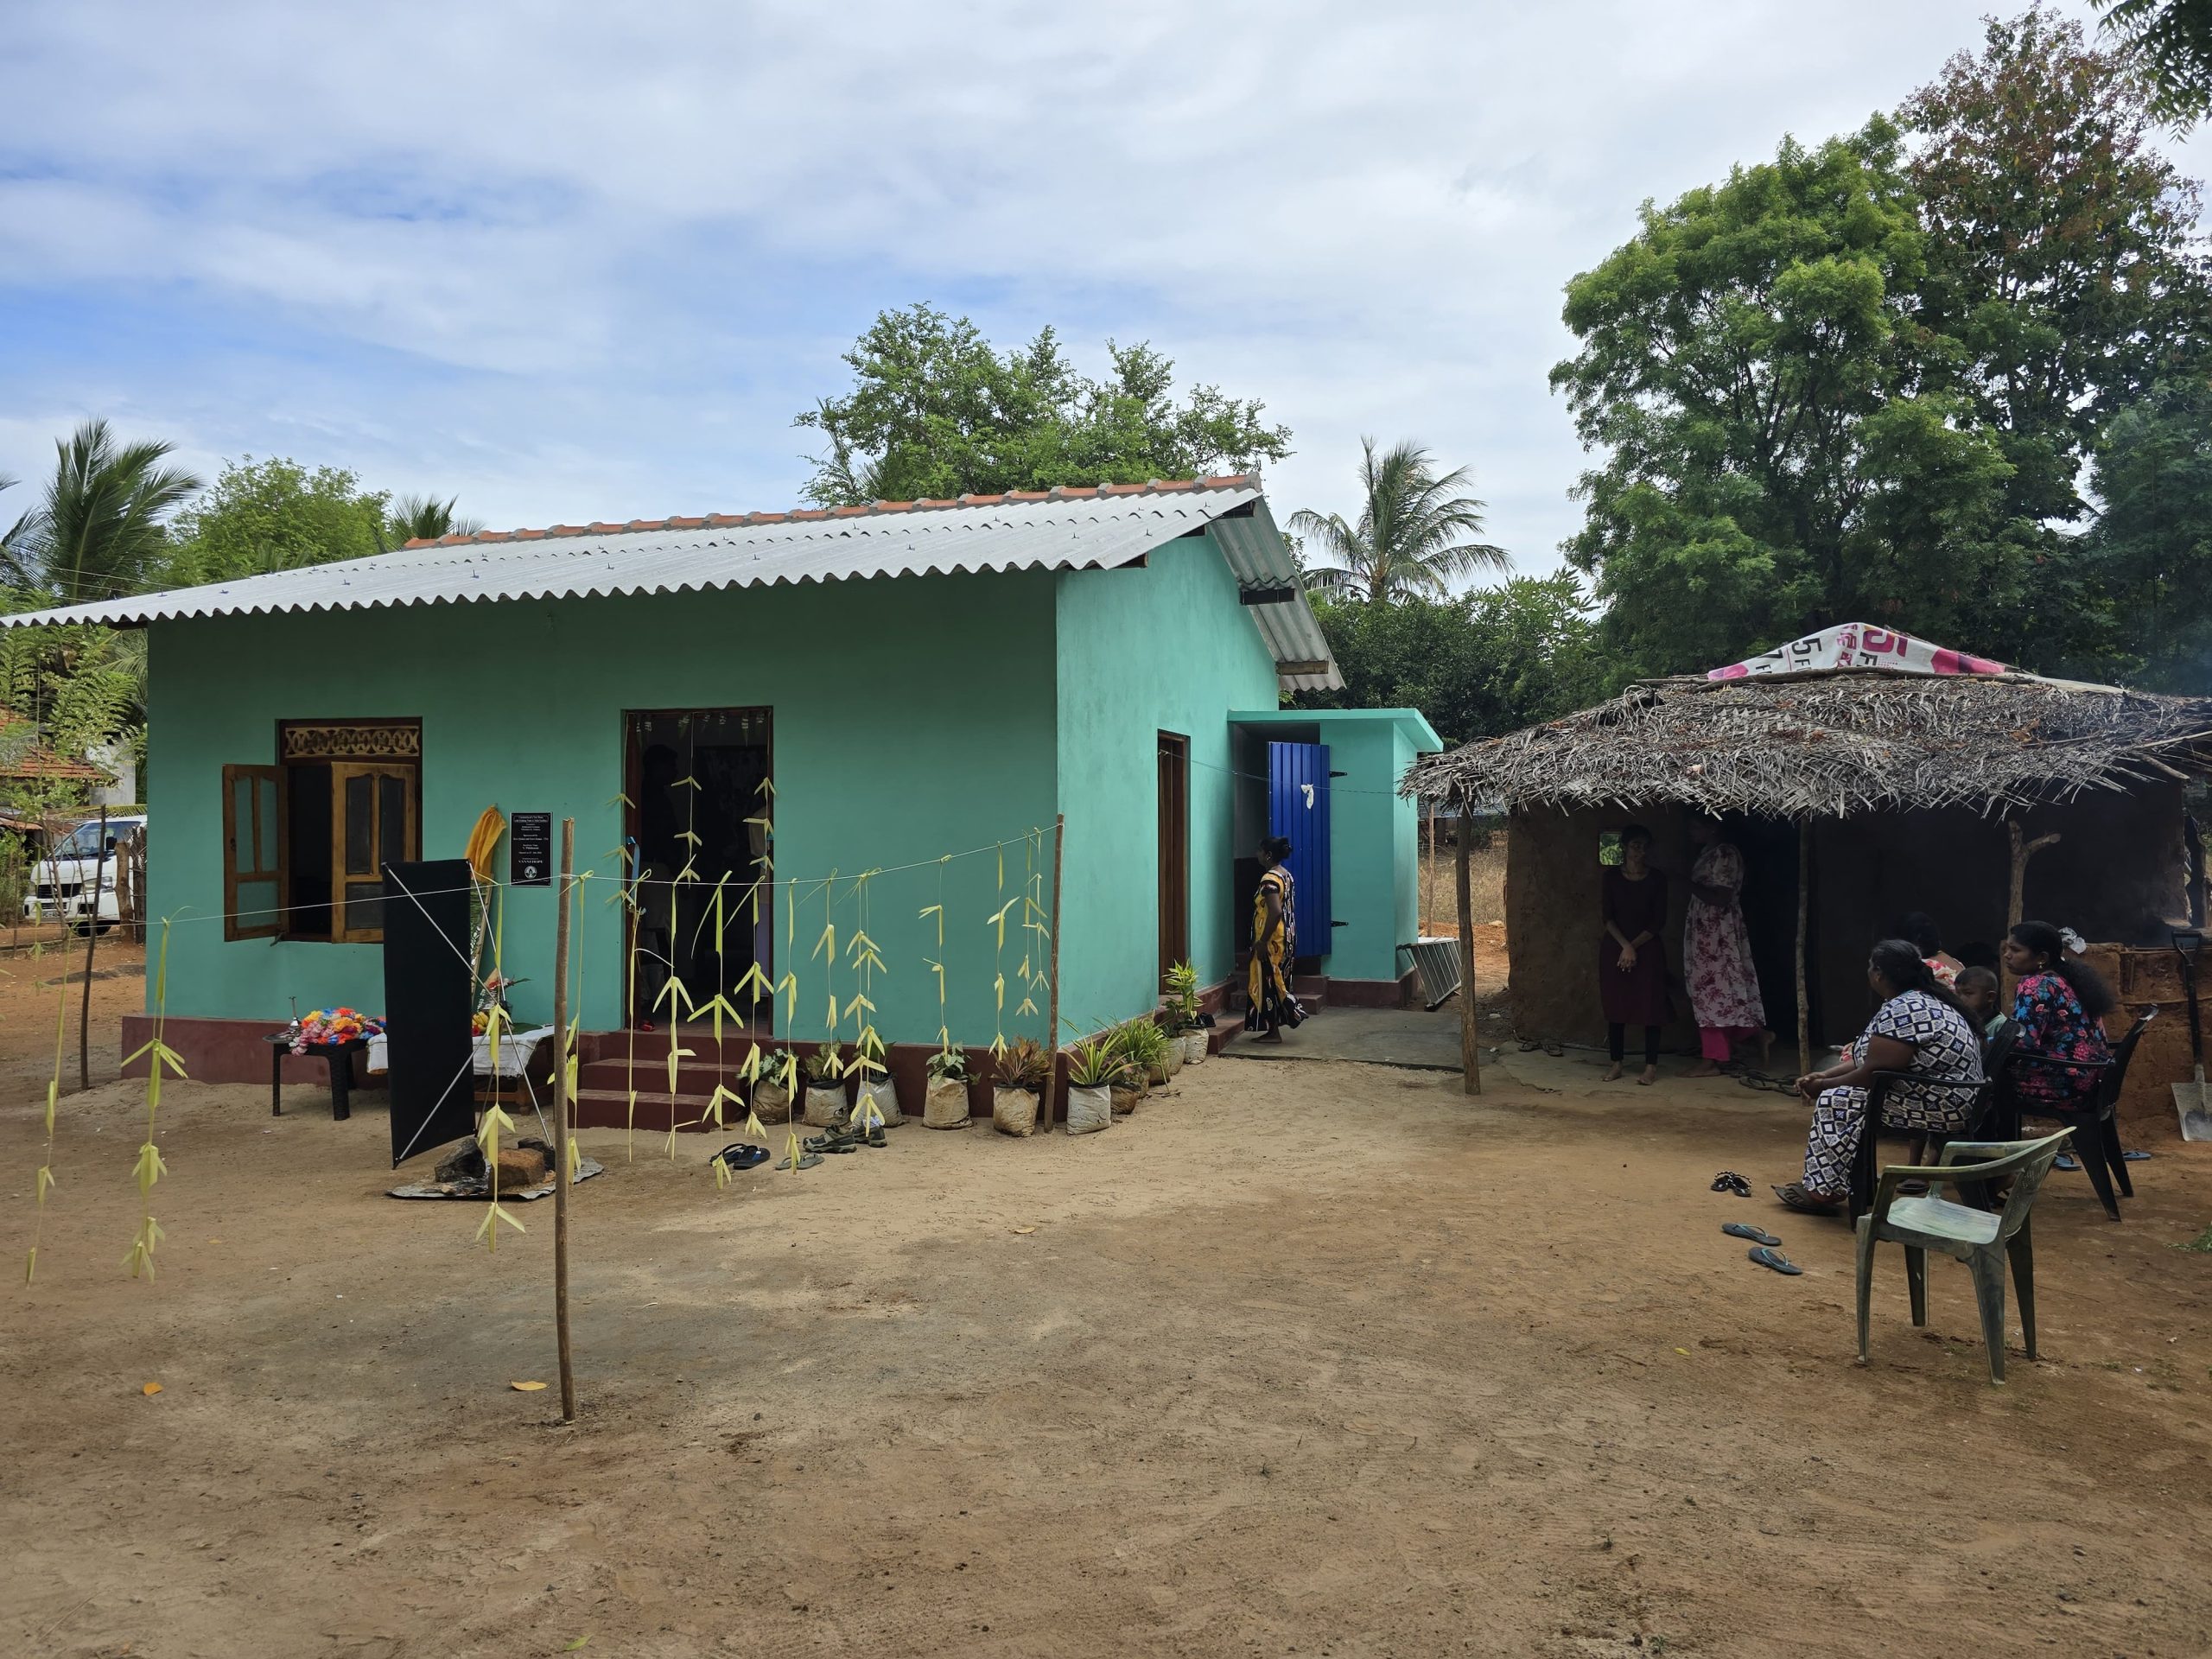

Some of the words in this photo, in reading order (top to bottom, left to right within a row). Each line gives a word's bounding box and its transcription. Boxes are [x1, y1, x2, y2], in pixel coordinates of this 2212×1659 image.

[1791, 638, 1822, 655] 5
[1795, 658, 1812, 671] F
[1857, 652, 1878, 667] F
[1755, 664, 1772, 674] F
